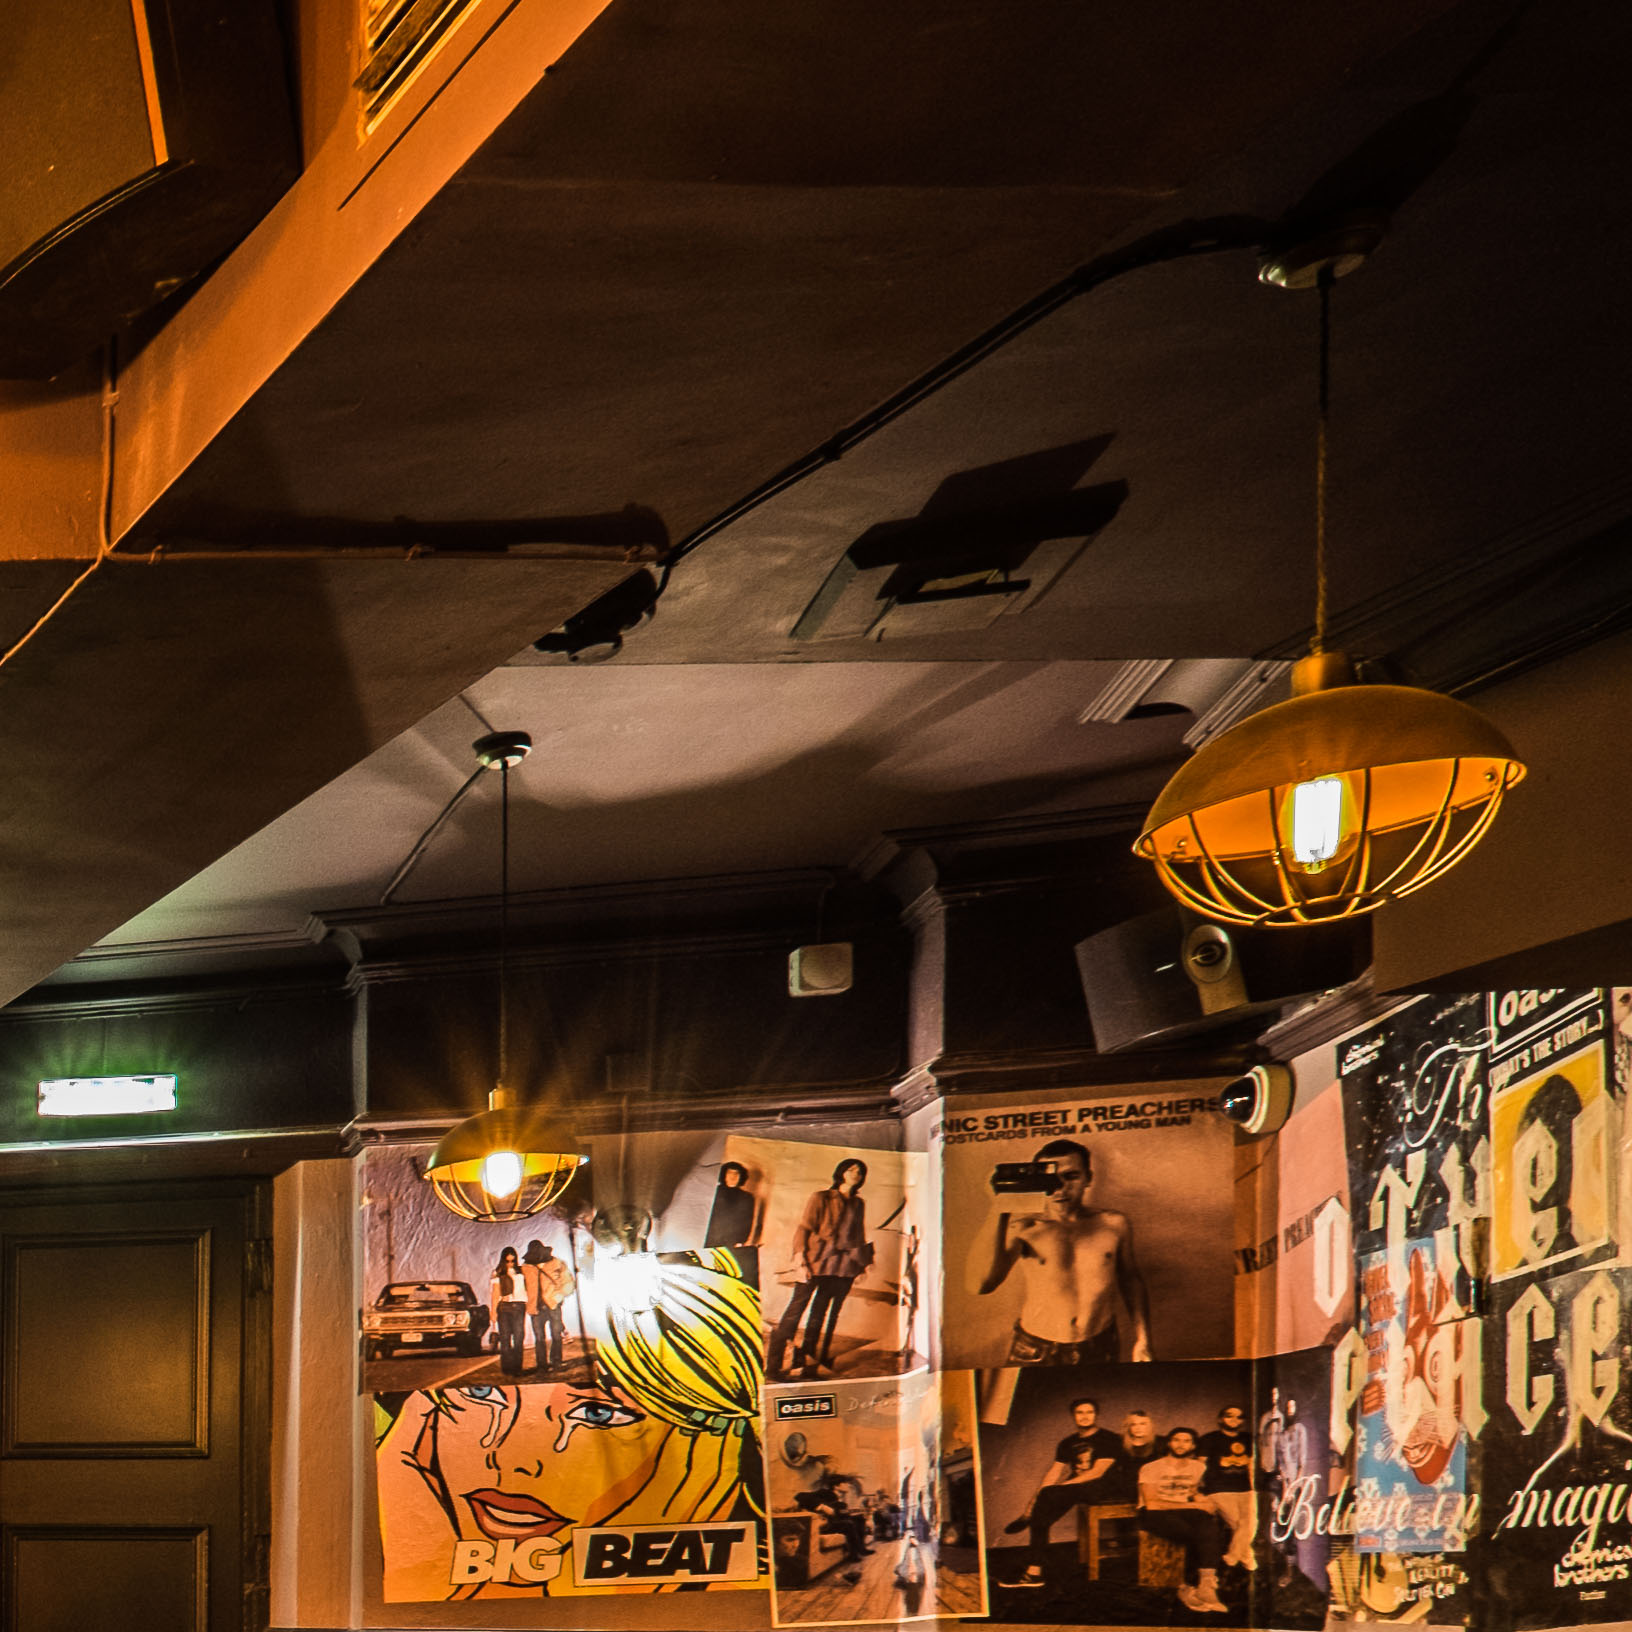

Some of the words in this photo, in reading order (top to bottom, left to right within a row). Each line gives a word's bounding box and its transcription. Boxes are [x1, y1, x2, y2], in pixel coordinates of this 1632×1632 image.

[941, 1128, 1028, 1144] OSTCARDS
[1031, 1123, 1076, 1137] FROM
[1080, 1122, 1092, 1134] A
[1095, 1116, 1153, 1132] YOUNG
[1155, 1114, 1192, 1128] MAN
[983, 1108, 1072, 1131] STREET
[1077, 1097, 1220, 1123] PREACHERS
[781, 1400, 830, 1415] oasis
[1270, 1474, 1416, 1543] Believe
[450, 1536, 564, 1586] BIG
[584, 1527, 746, 1580] BEAT
